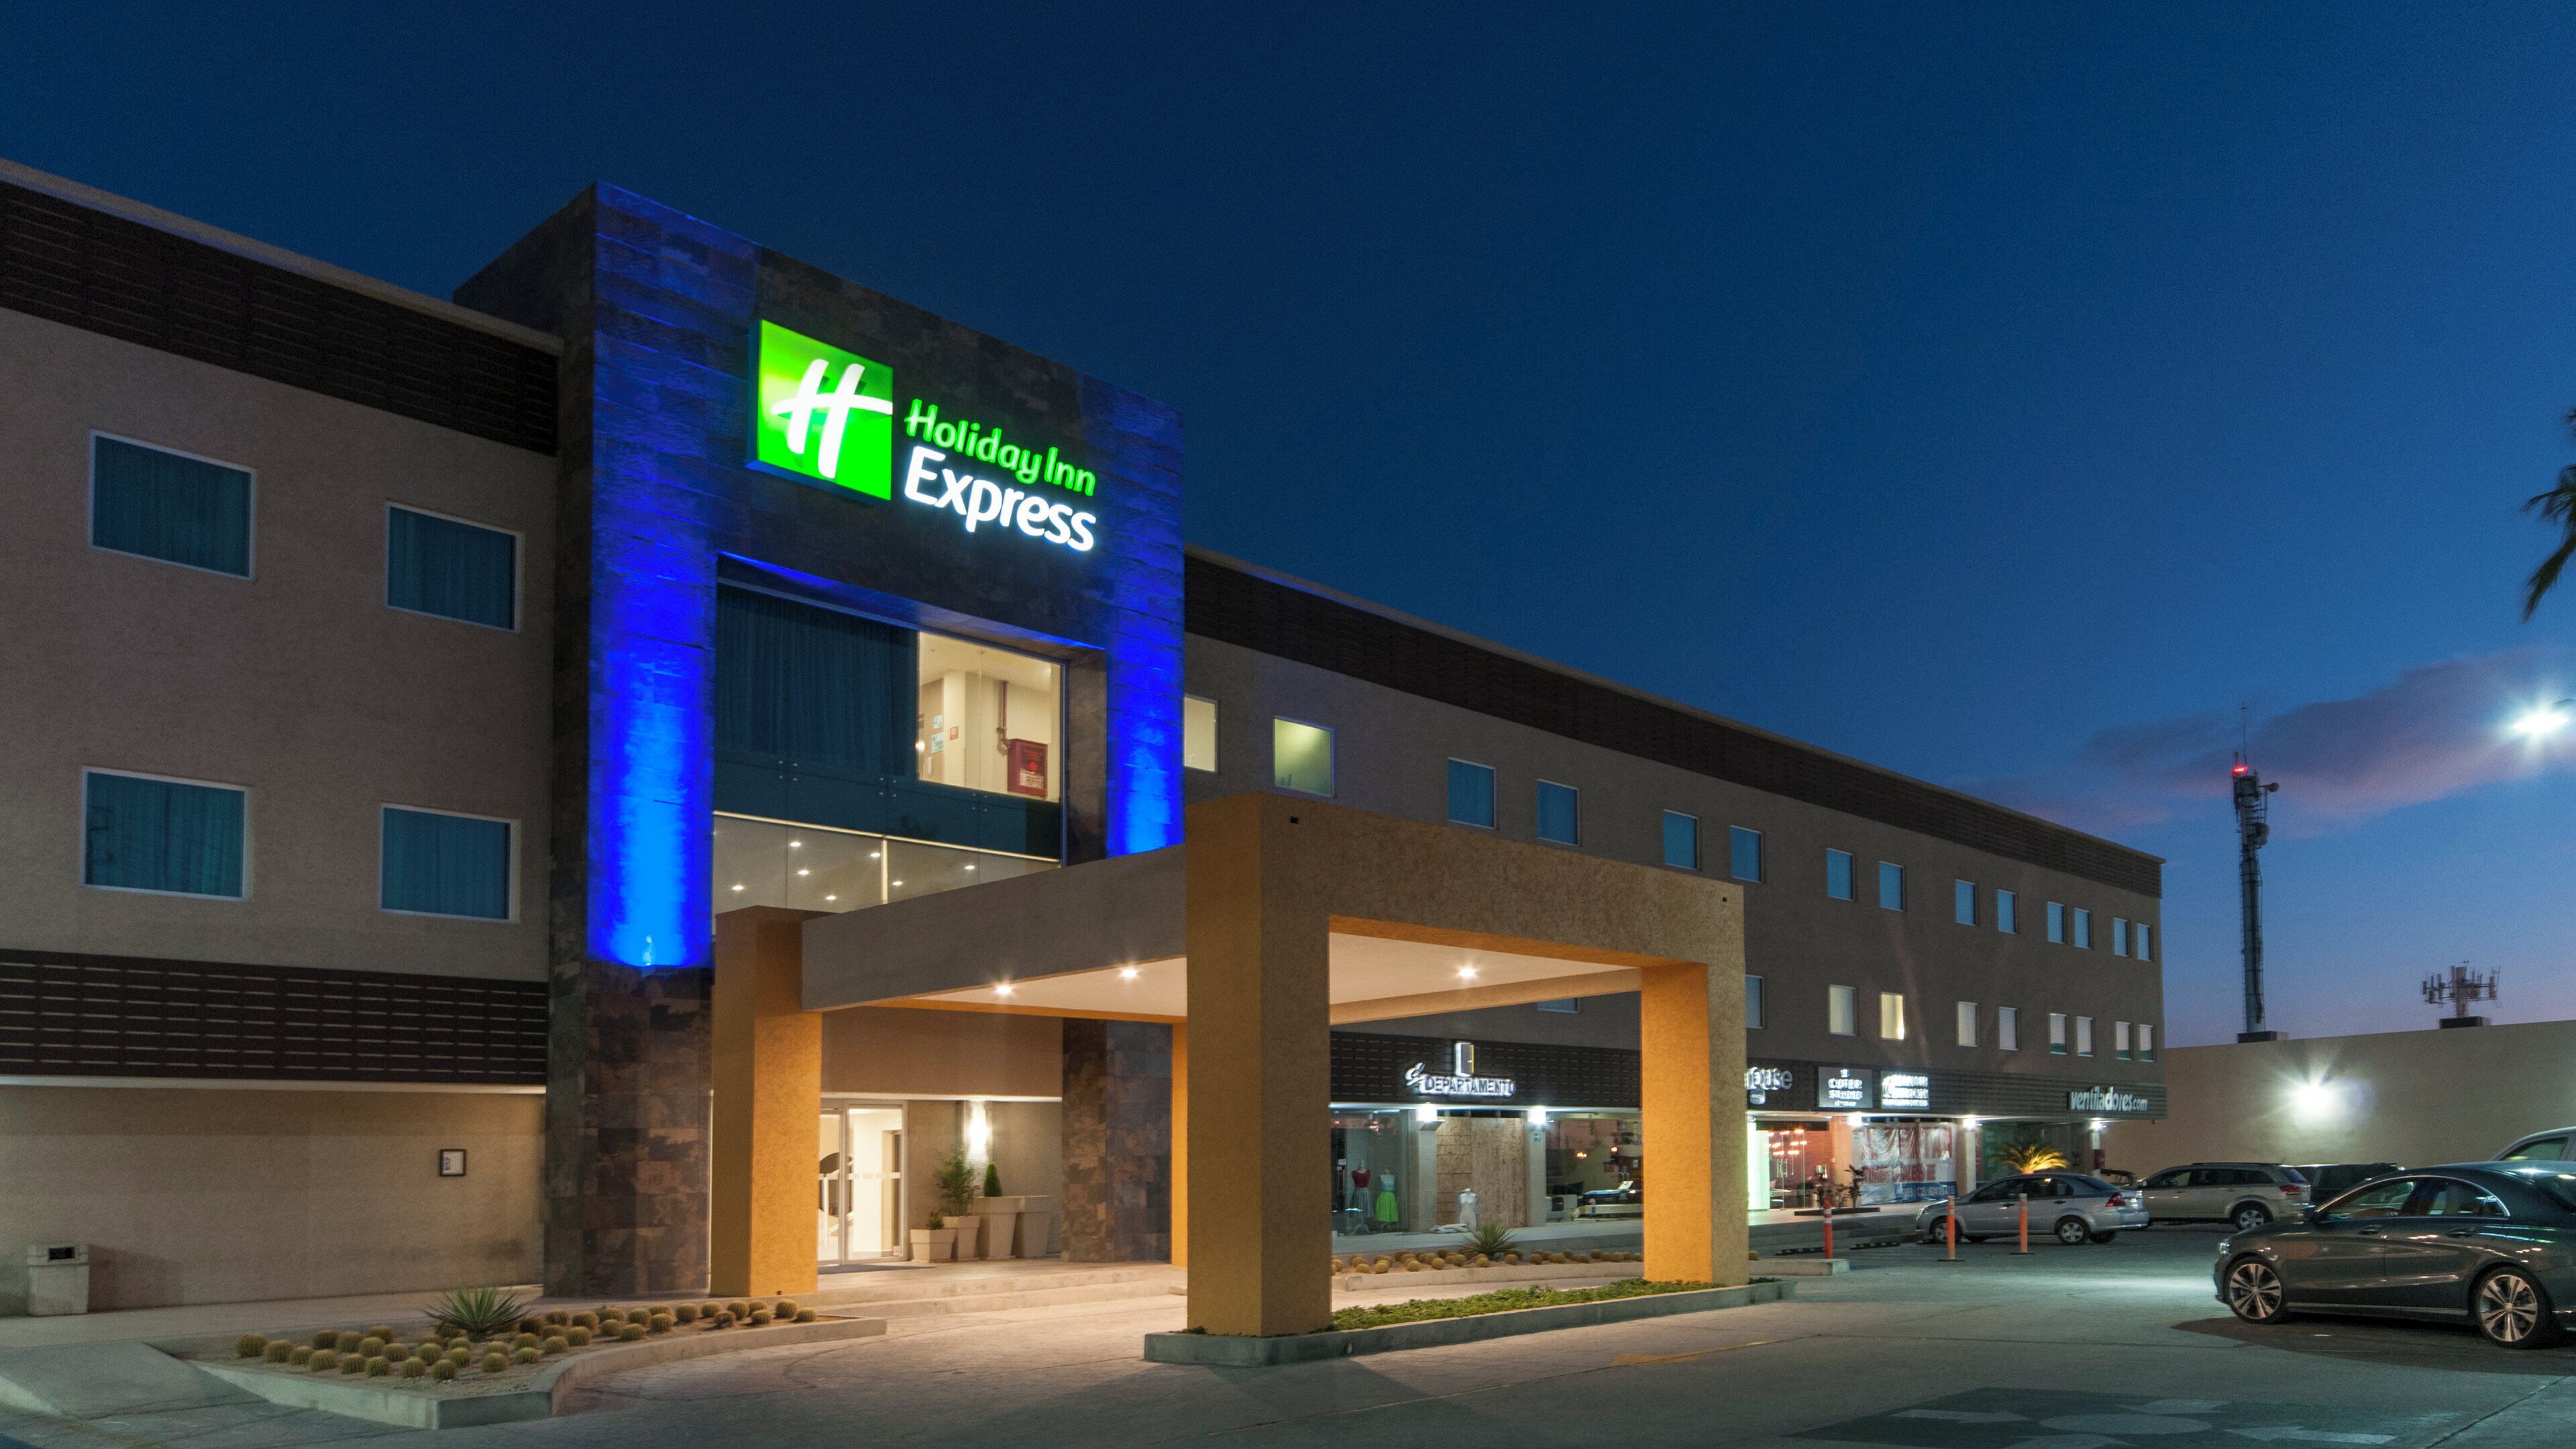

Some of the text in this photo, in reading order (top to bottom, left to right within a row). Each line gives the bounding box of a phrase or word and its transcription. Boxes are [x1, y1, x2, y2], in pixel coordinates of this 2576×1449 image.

[904, 398, 1095, 496] Holiday Inn
[905, 445, 1096, 551] Express
[1424, 1075, 1516, 1095] DEPARTAMENTO
[2070, 1086, 2148, 1112] ventiladores.com
